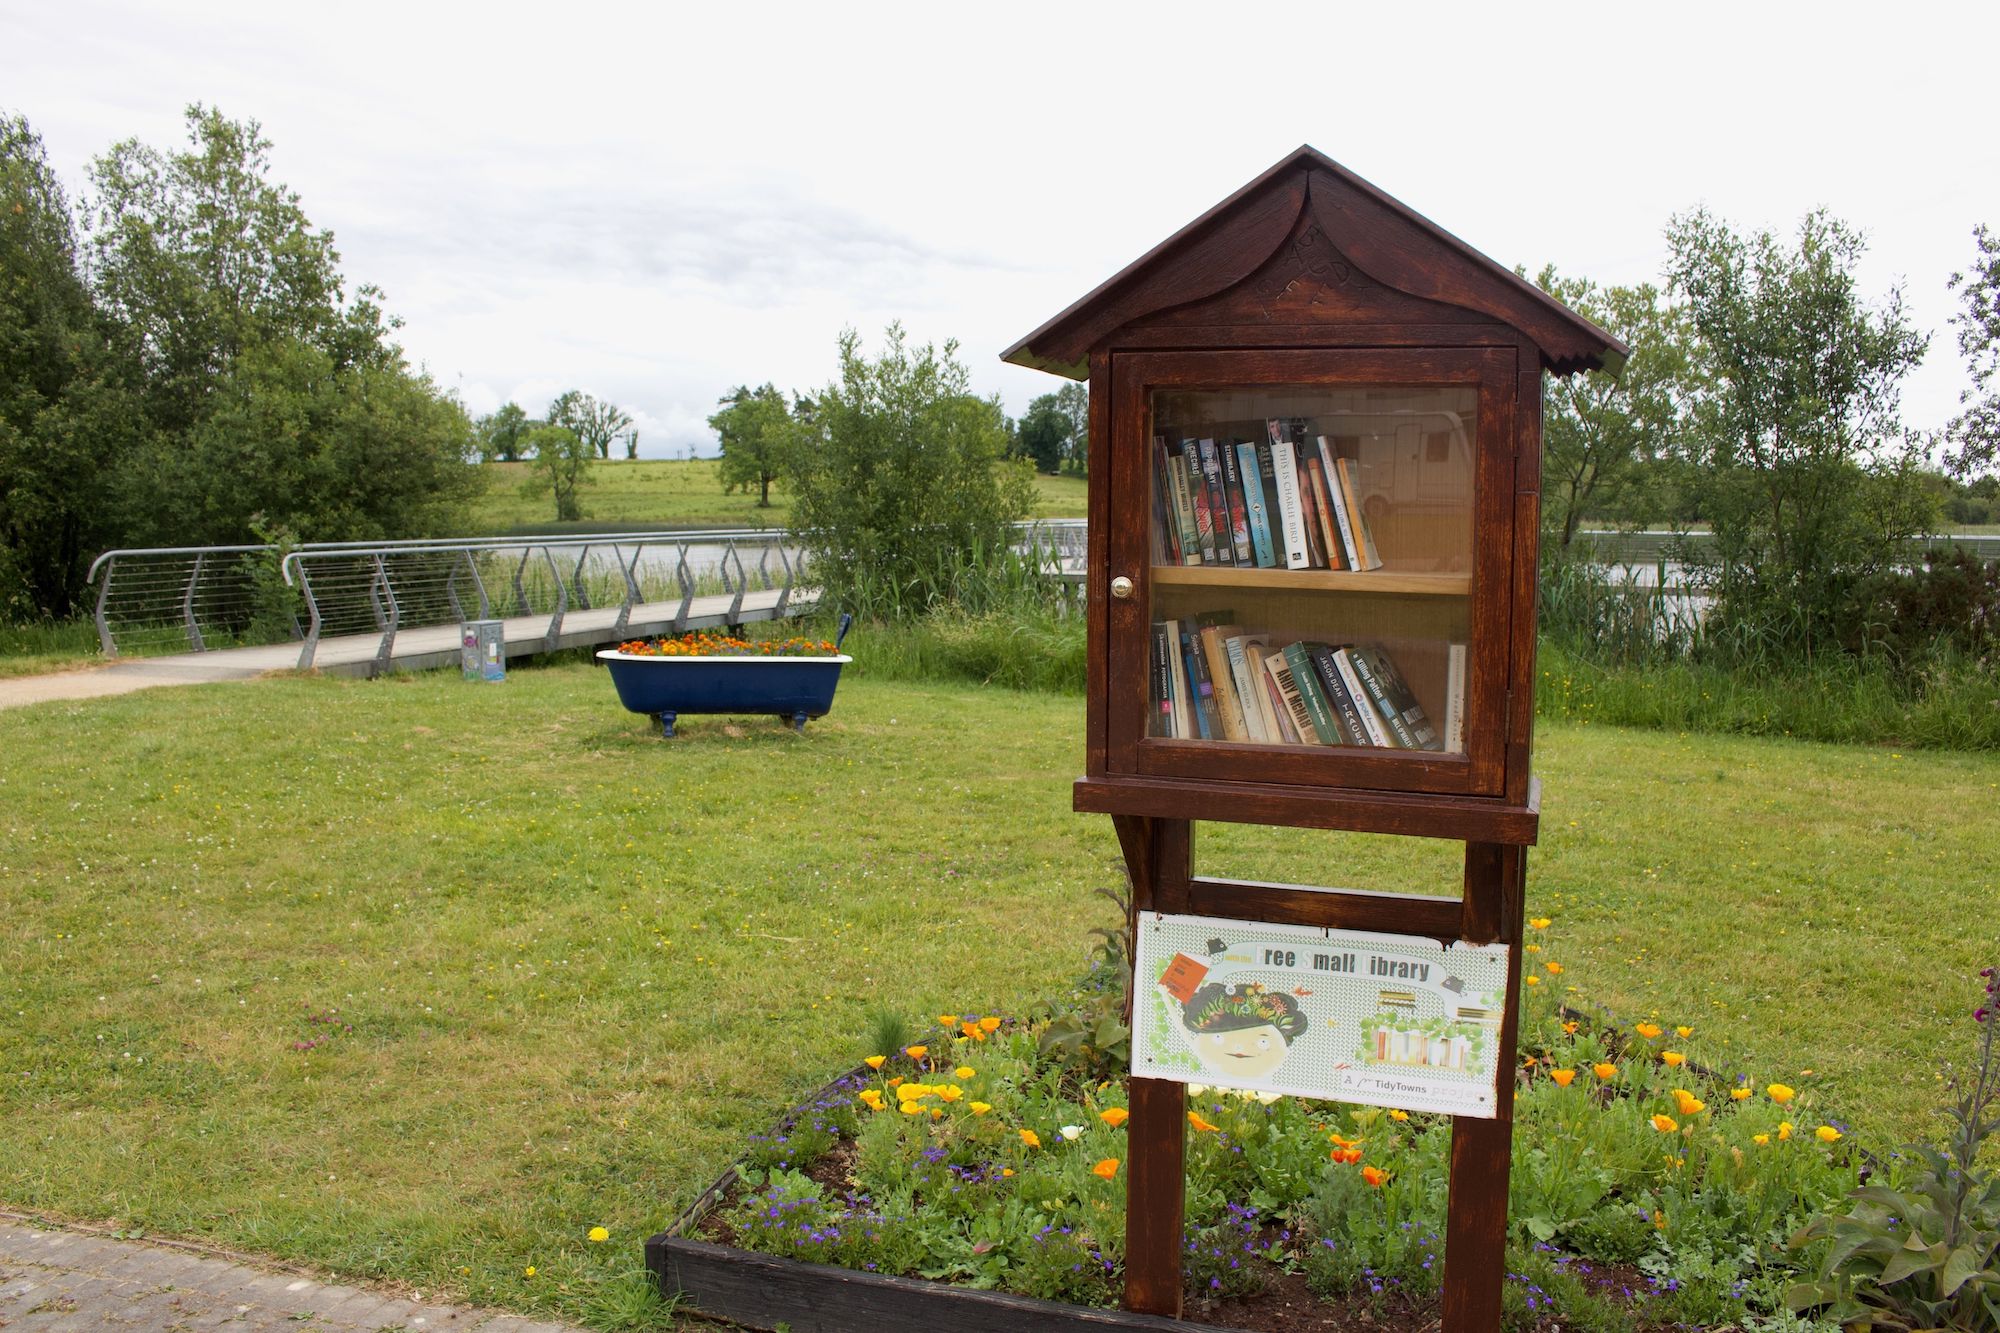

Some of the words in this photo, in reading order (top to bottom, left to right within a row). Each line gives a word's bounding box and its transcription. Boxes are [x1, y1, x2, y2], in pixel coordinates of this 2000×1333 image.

[1279, 447, 1288, 469] THIS
[1282, 471, 1289, 480] IS
[1283, 481, 1296, 520] CHARLIE
[1289, 522, 1299, 543] BIRD
[1276, 668, 1299, 695] ANDY
[1355, 658, 1371, 680] Killing
[1366, 678, 1384, 700] Patton
[1319, 656, 1334, 678] JASON
[1330, 679, 1344, 698] DEAN
[1342, 703, 1366, 746] TRACER
[1391, 717, 1401, 729] BILL
[1375, 1079, 1428, 1094] TidyTowns
